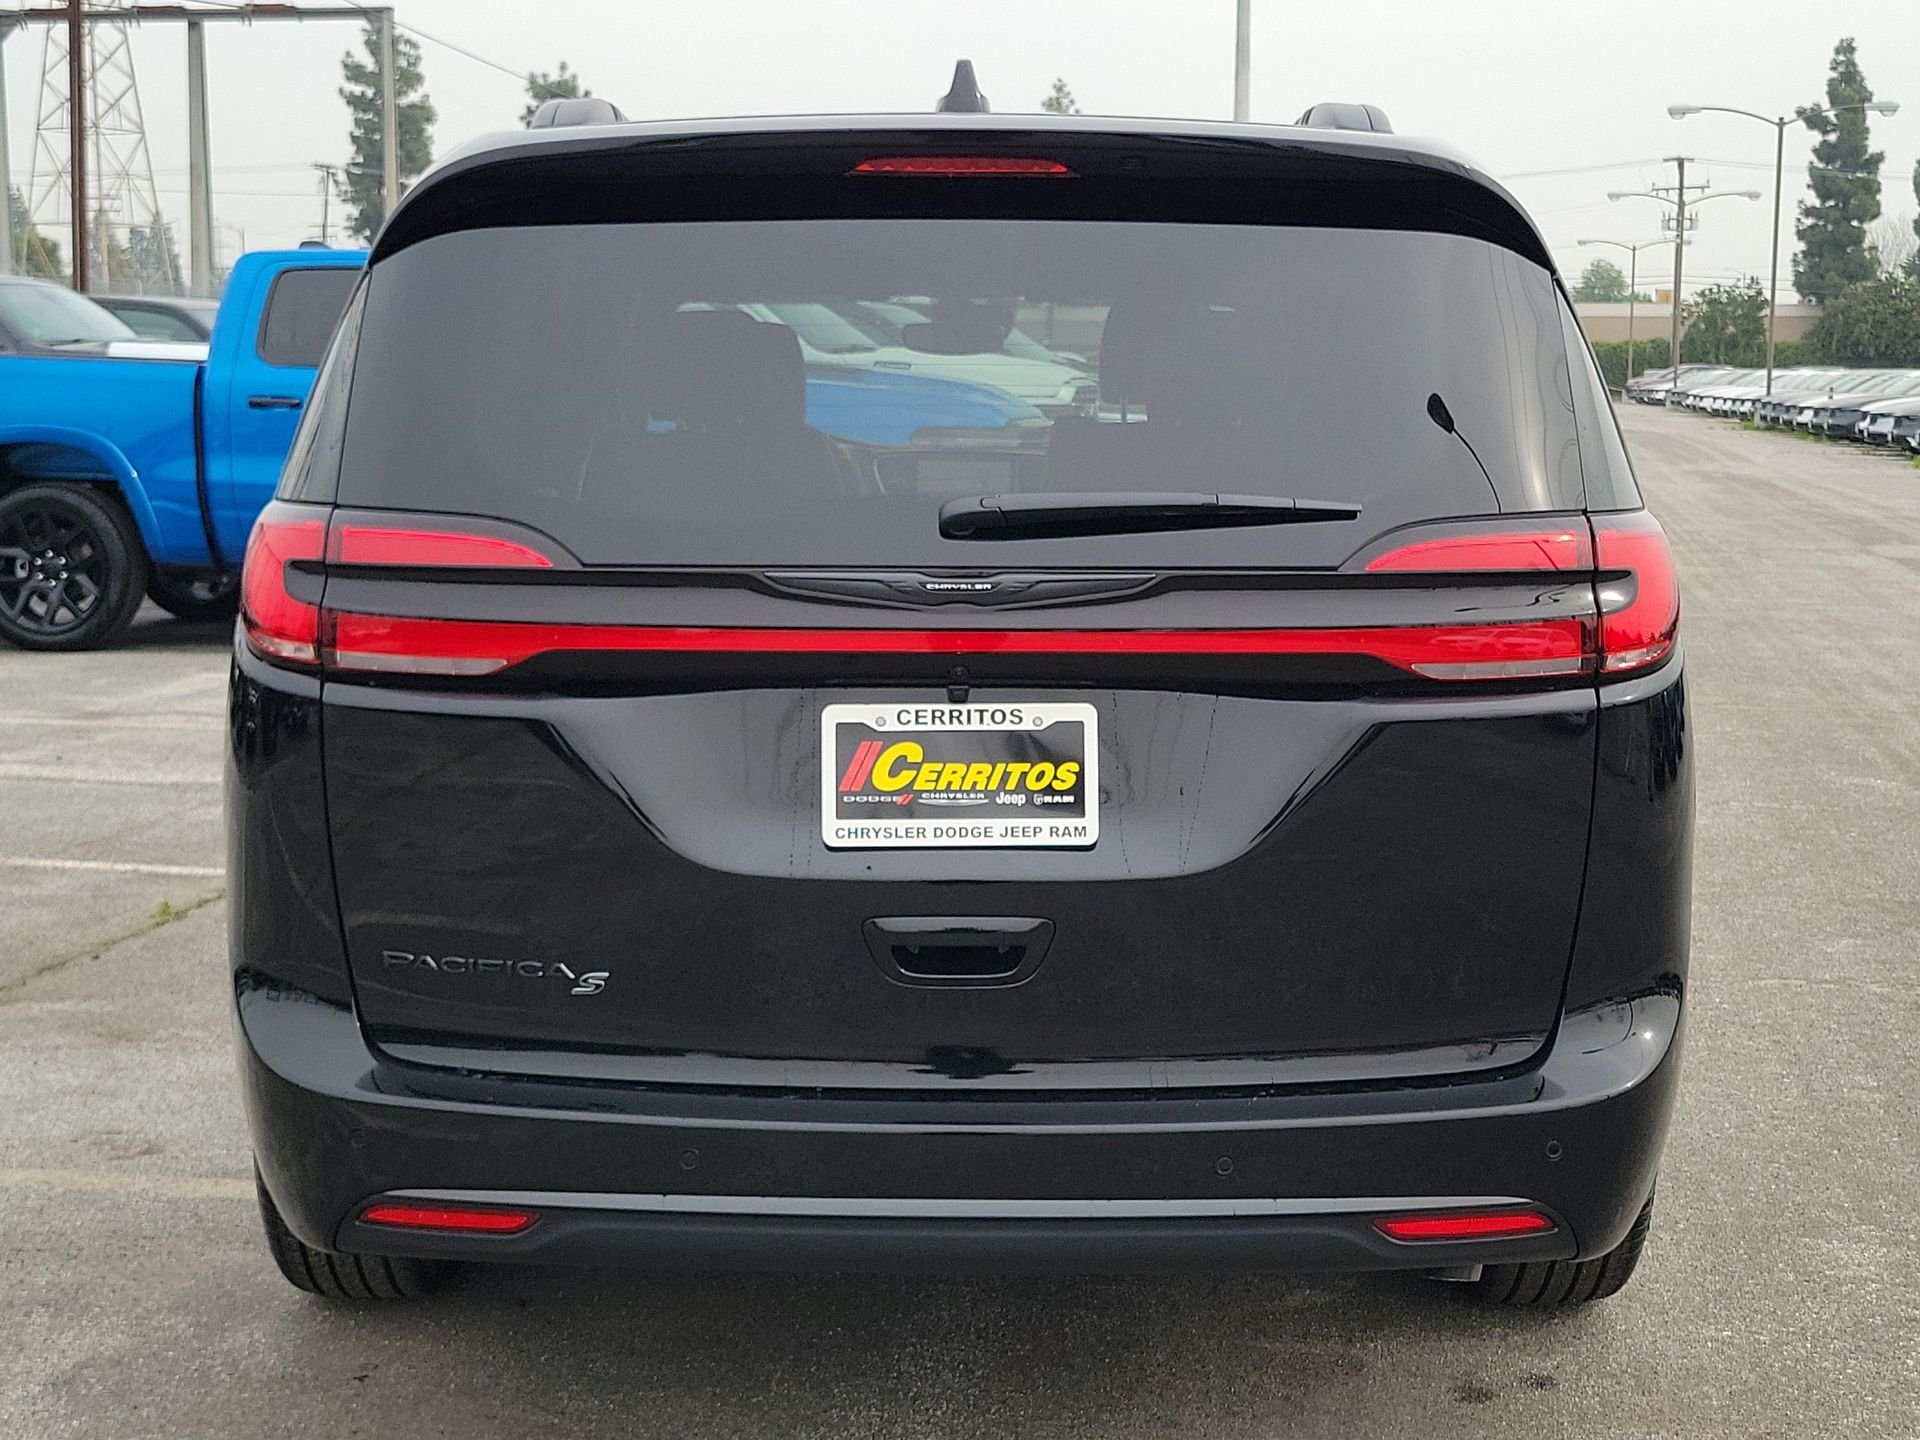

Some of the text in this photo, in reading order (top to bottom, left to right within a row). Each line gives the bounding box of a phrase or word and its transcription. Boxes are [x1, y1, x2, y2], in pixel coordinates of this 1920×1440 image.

[896, 708, 1024, 726] CERRITOS
[871, 741, 1080, 792] CERRITOS
[843, 795, 904, 803] DODGE
[995, 791, 1026, 807] Jeep
[1042, 794, 1075, 803] RAM
[835, 826, 1087, 839] CHRYSLER DODGE JEEP RAM
[383, 950, 576, 980] PACIFICA
